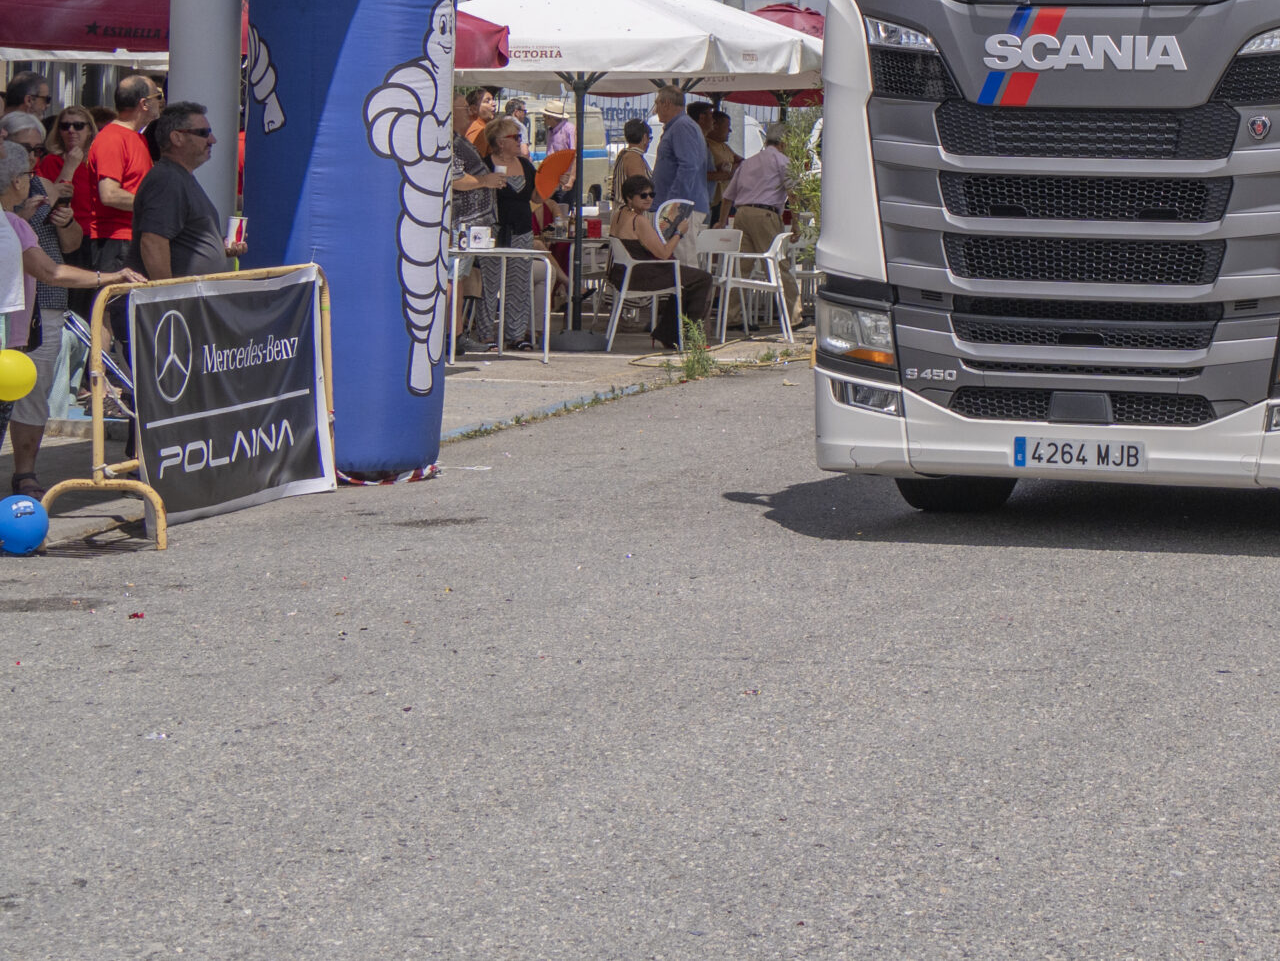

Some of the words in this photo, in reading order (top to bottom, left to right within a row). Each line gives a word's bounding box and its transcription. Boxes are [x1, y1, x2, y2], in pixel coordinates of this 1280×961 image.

[509, 50, 562, 59] ICTORIA
[983, 33, 1188, 71] SCANIA
[203, 335, 299, 374] Mercedes-Benz
[905, 368, 918, 381] S
[920, 368, 957, 381] 450
[159, 419, 294, 479] POLAINA
[1031, 442, 1088, 465] 4264
[1096, 444, 1140, 467] MJB
